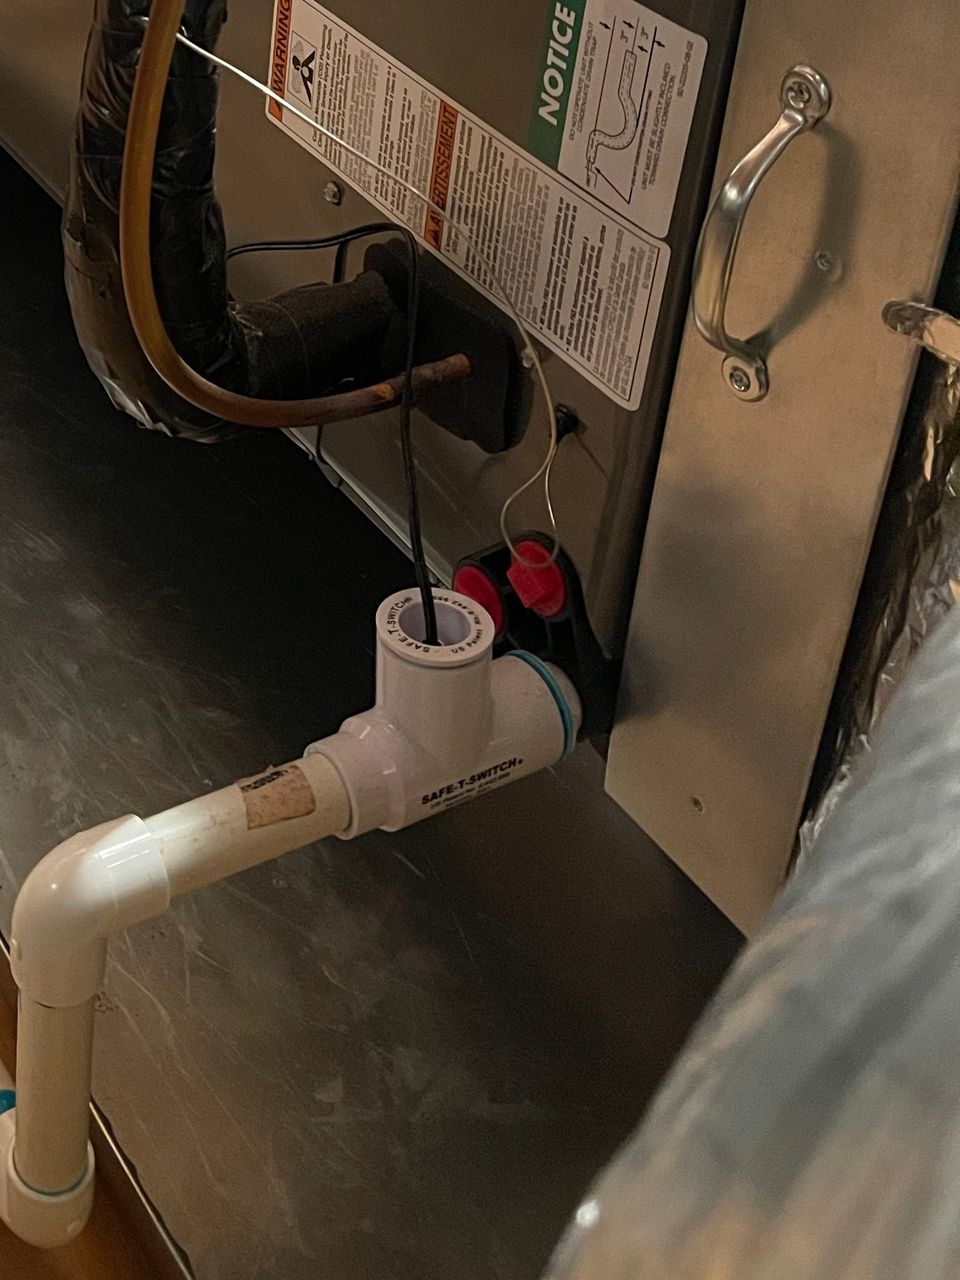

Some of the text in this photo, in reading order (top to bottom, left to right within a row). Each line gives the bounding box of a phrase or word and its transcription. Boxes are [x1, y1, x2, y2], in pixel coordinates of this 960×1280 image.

[537, 0, 575, 127] NOTICE
[573, 75, 584, 112] OPERATE
[576, 81, 589, 133] CONDENSATE
[585, 56, 593, 82] DRAIN
[568, 127, 575, 141] DO
[570, 110, 578, 128] NOT
